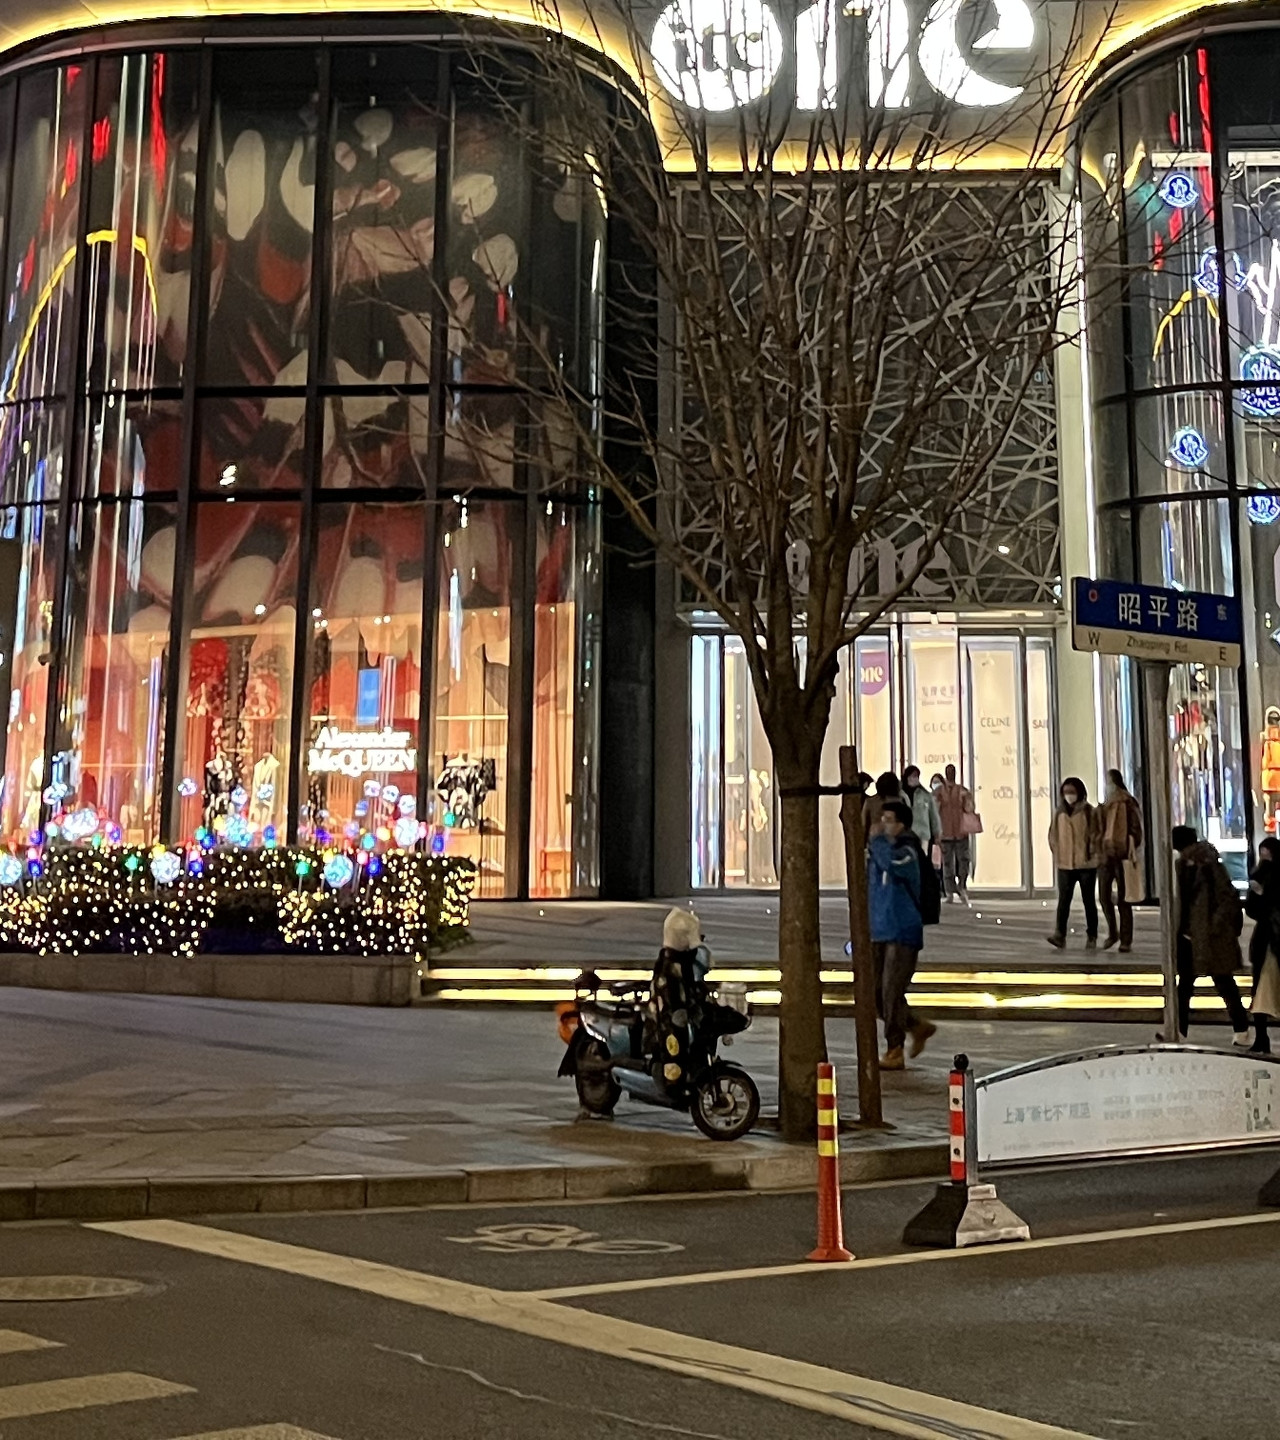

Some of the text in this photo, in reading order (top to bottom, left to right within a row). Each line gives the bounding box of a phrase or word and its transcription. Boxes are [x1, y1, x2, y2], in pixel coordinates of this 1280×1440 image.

[1118, 592, 1199, 632] 昭平路
[1087, 631, 1101, 647] W
[1219, 646, 1227, 661] E
[980, 716, 1011, 728] CELINE
[308, 748, 418, 777] McQUEEN
